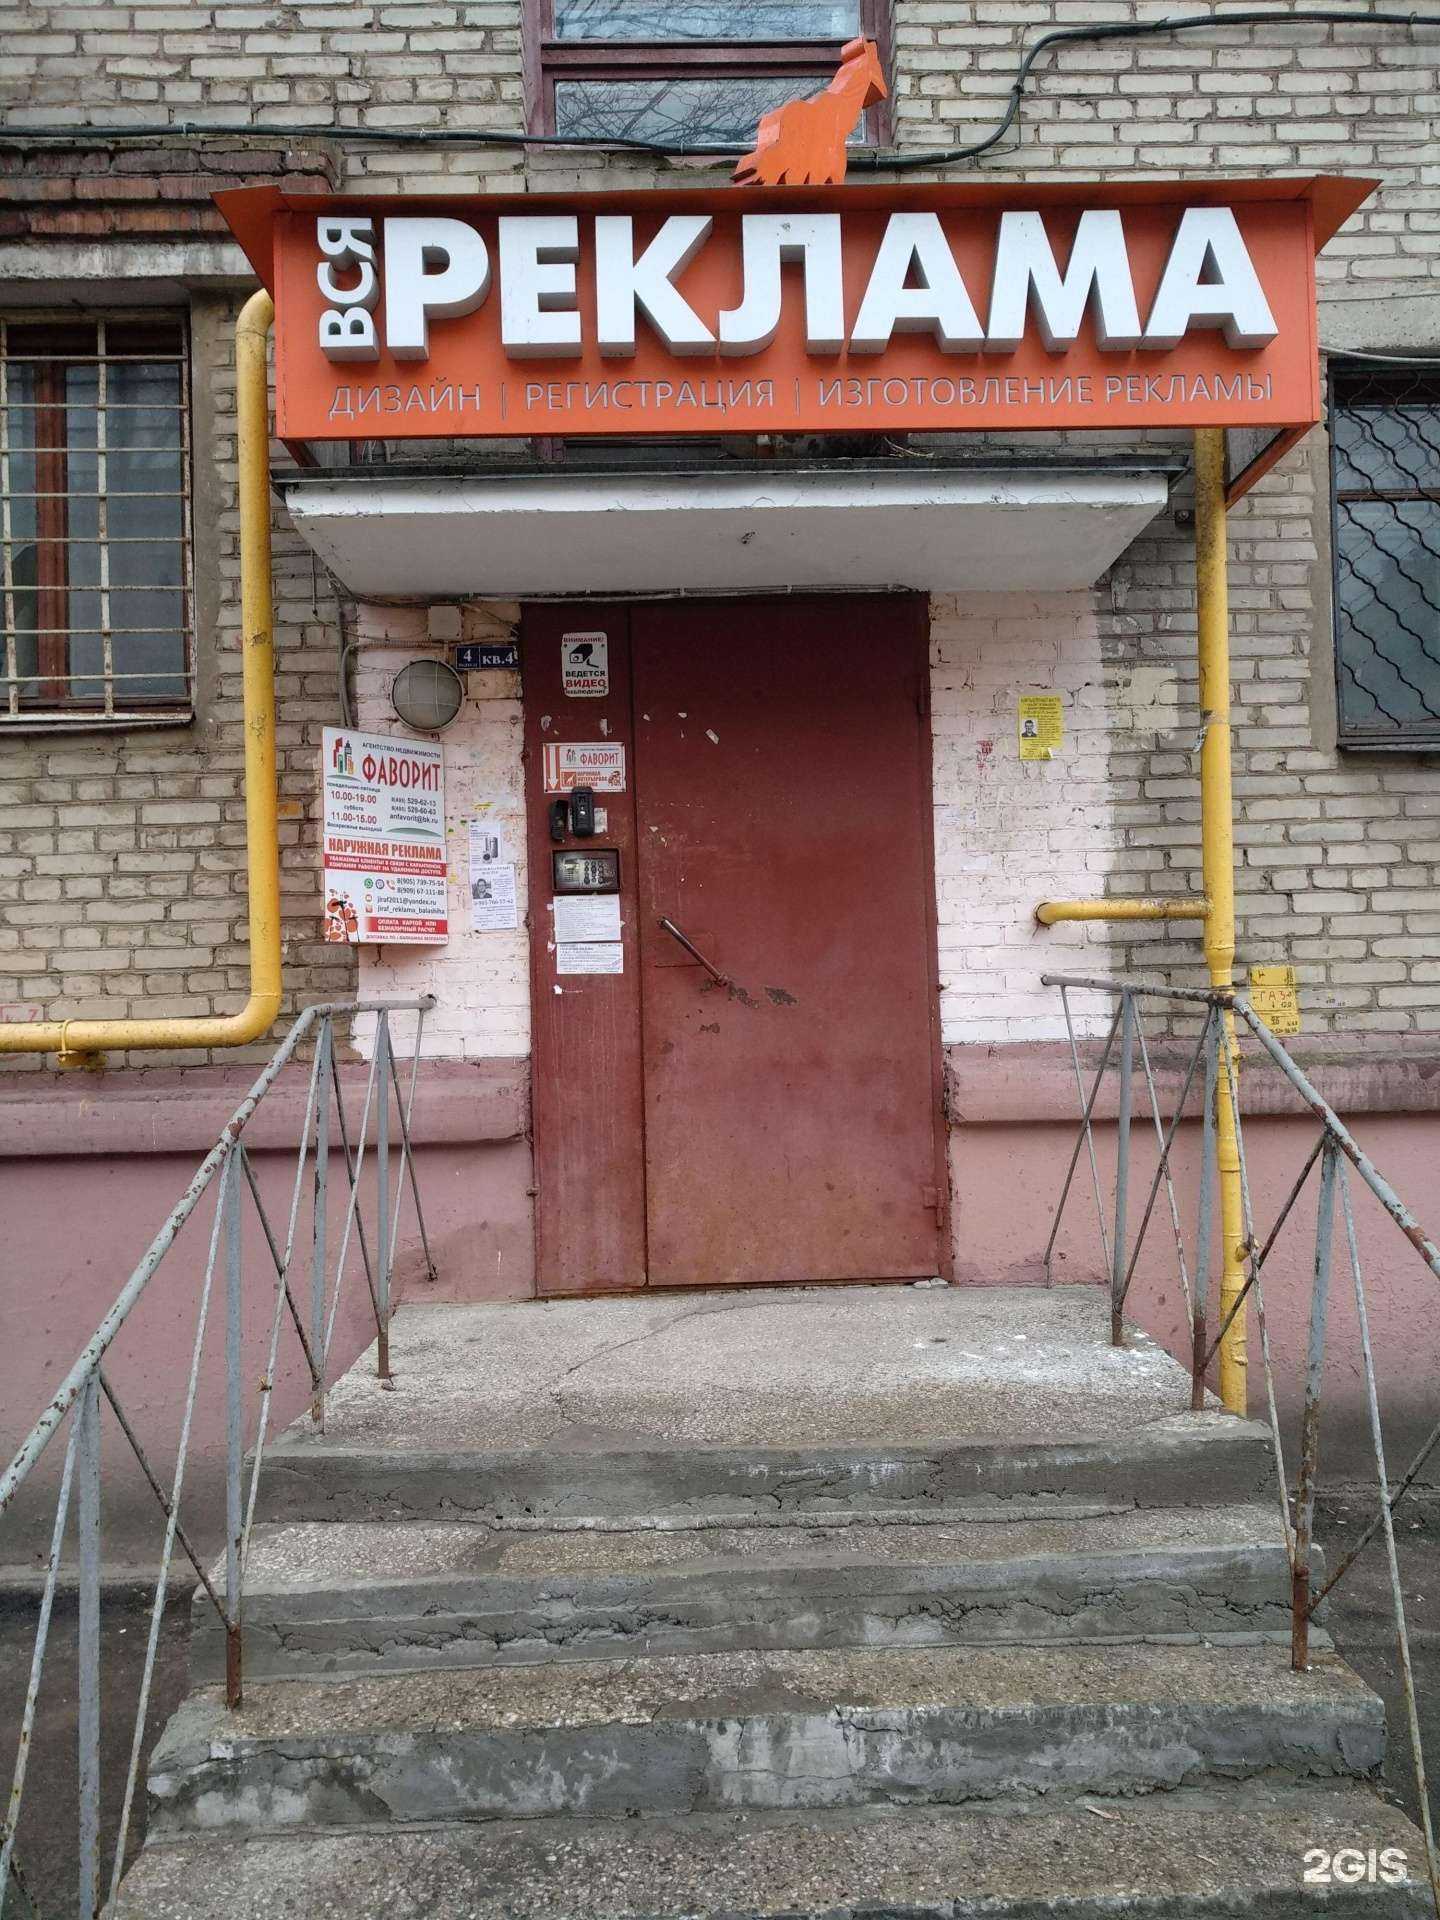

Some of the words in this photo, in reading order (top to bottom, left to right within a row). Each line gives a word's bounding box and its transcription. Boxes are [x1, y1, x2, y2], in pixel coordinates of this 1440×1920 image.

[317, 216, 377, 360] ВСЯ
[384, 206, 1279, 360] РЕКЛАМА
[328, 377, 481, 420] ДИЗАЙН
[526, 379, 775, 413] РЕГИСТРАЦИЯ
[818, 374, 1093, 408] ИЗГОТОВЛЕНИЕ
[1106, 372, 1273, 404] РЕКЛАМЫ
[463, 648, 472, 662] 4
[565, 670, 606, 678] ВЕДЕТСЯ
[565, 679, 606, 688] ВИДЕО
[362, 742, 395, 753] АГЕНТСТВО
[395, 747, 441, 759] НЕДВИЖИМОСТИ
[580, 752, 620, 765] ФАВОРИТ
[362, 753, 441, 792] ФАВОРИТ
[331, 790, 377, 804] 10.00-19.00
[332, 811, 378, 825] 11.00-15.00
[329, 838, 389, 856] НАРУЖНАЯ
[391, 844, 442, 860] РЕКЛАМА
